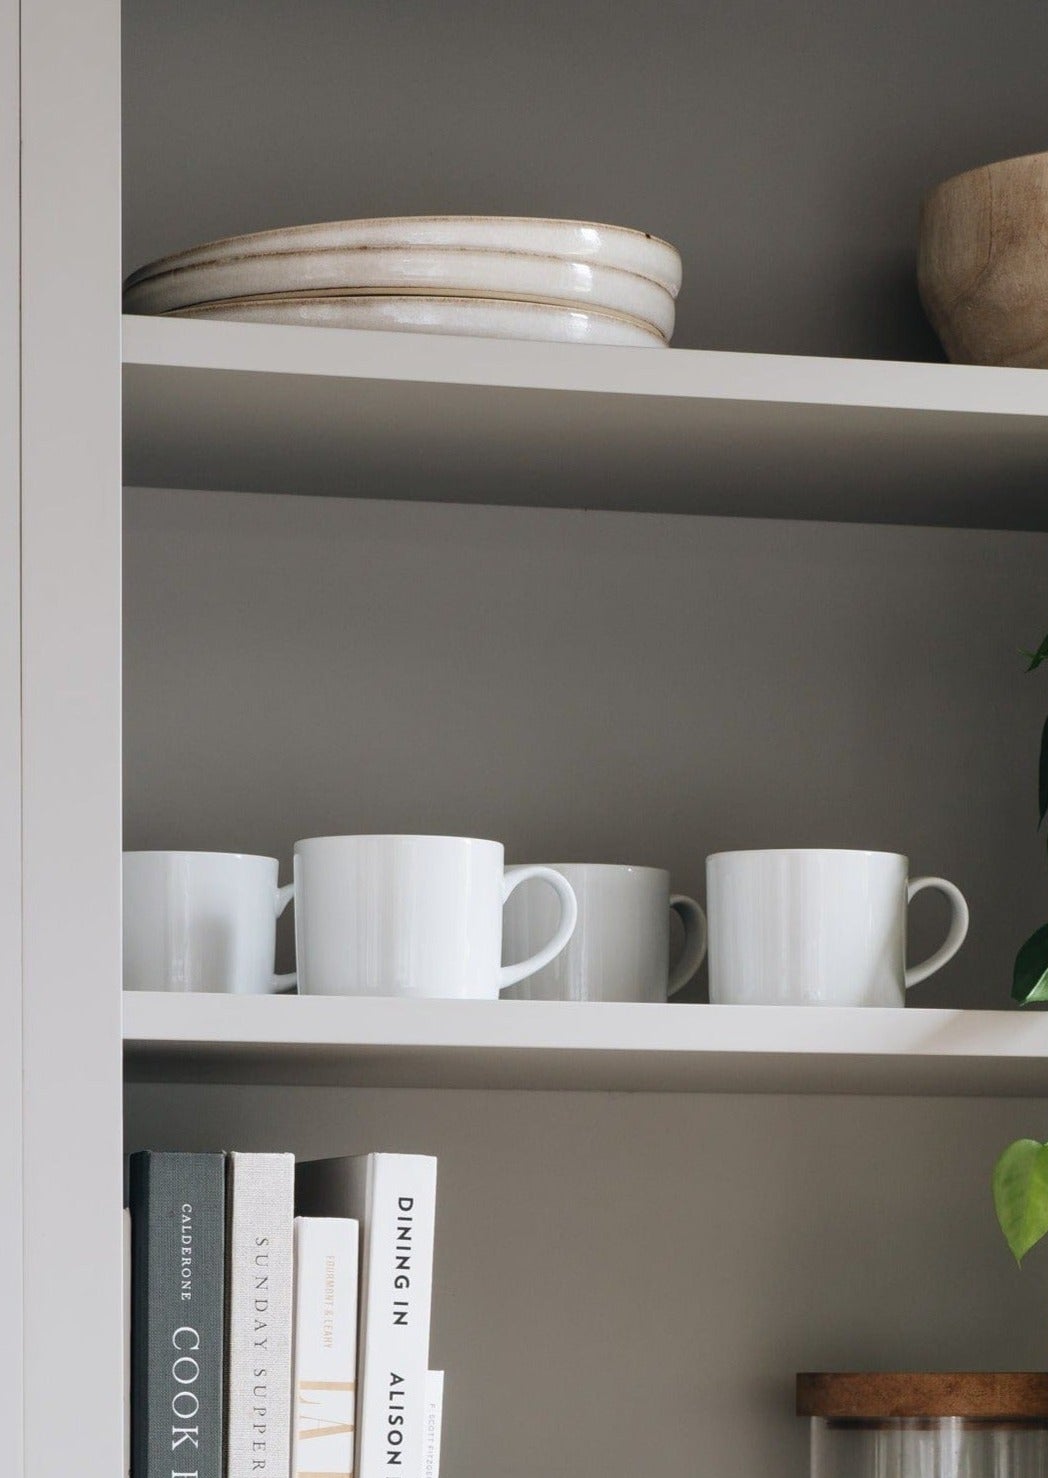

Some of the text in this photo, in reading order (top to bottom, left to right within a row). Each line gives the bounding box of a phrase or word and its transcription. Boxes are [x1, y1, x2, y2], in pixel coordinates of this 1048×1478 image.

[181, 1204, 192, 1300] CALDERONE
[254, 1237, 269, 1350] SUNDAY
[324, 1255, 336, 1305] FOURMONT
[393, 1197, 413, 1325] DINING IN
[323, 1319, 334, 1348] LEAHY
[172, 1327, 199, 1450] COOK
[297, 1381, 354, 1440] LA
[387, 1373, 404, 1464] ALISON
